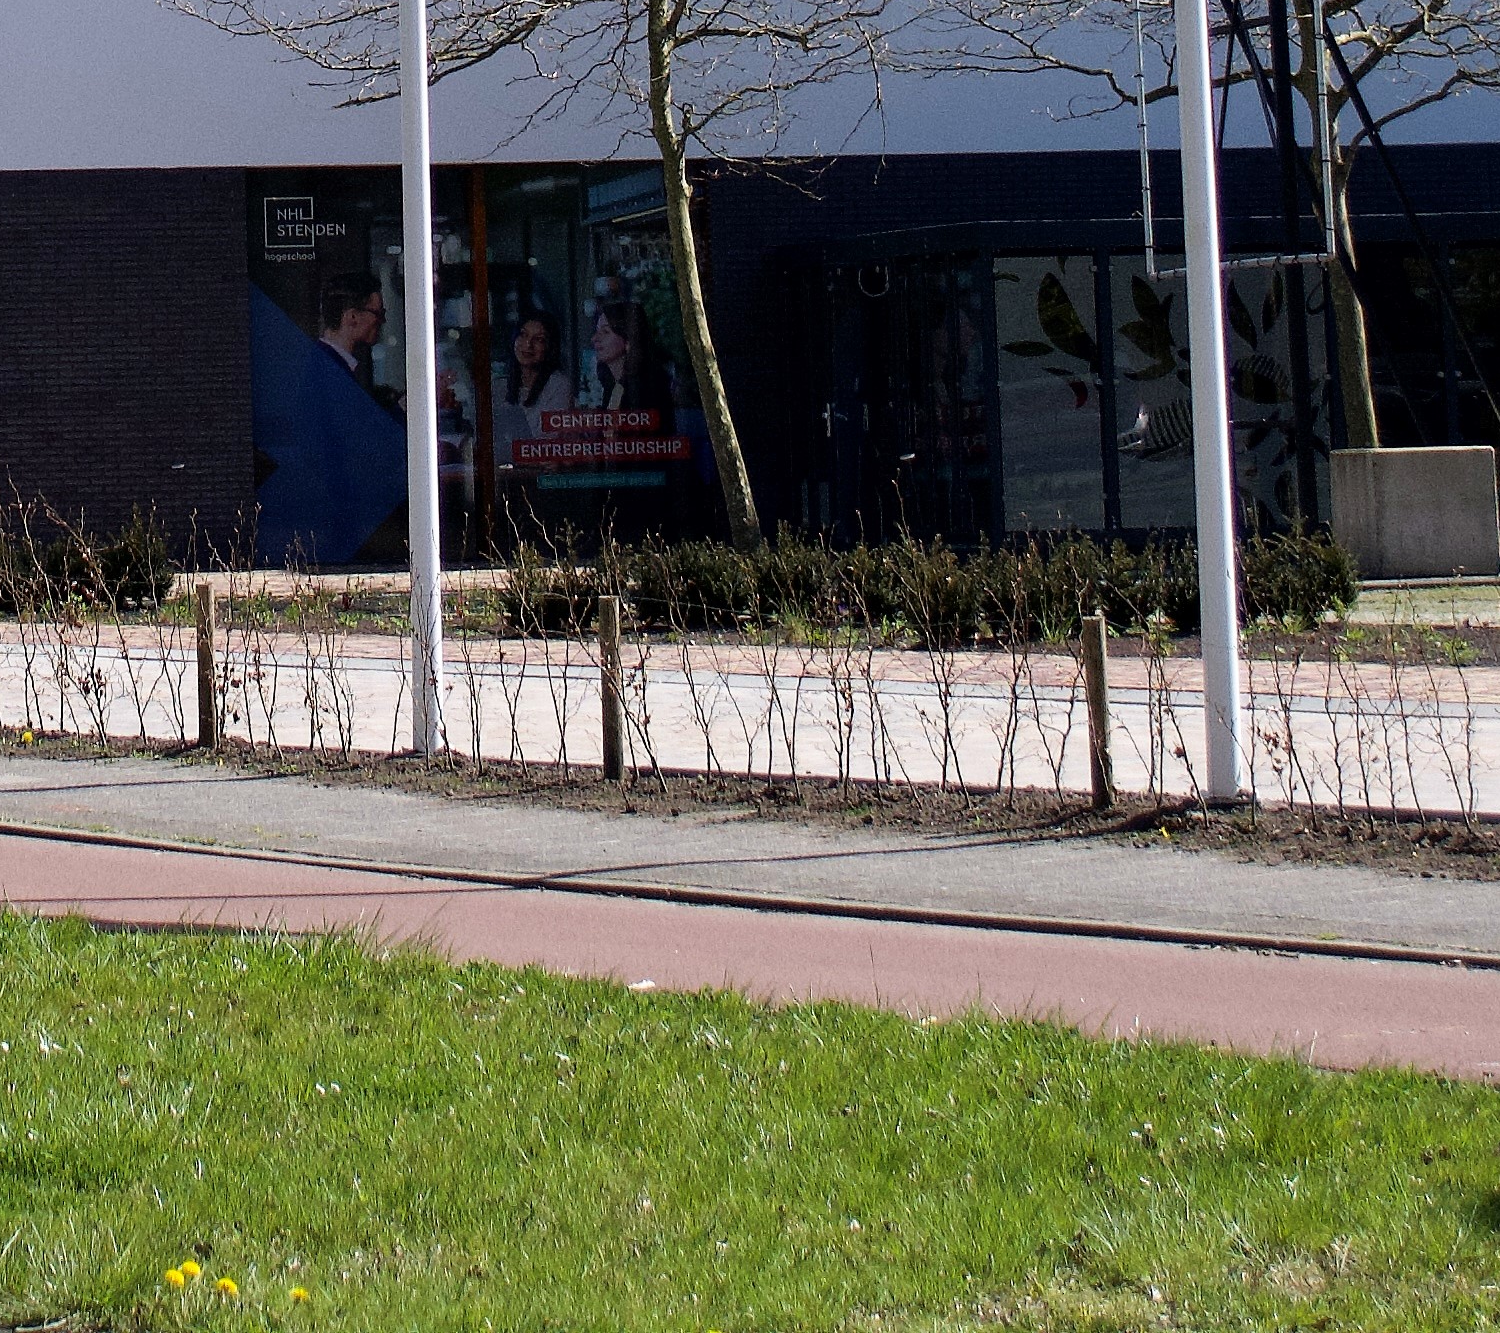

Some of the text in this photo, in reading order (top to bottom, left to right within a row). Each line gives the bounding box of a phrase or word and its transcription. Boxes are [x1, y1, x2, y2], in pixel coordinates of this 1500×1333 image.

[277, 207, 314, 221] NHL
[276, 223, 346, 237] STENDEN
[264, 251, 316, 262] hogeschool
[549, 412, 651, 428] CENTER FOR
[520, 440, 682, 458] ENTREPRENEURSHIP
